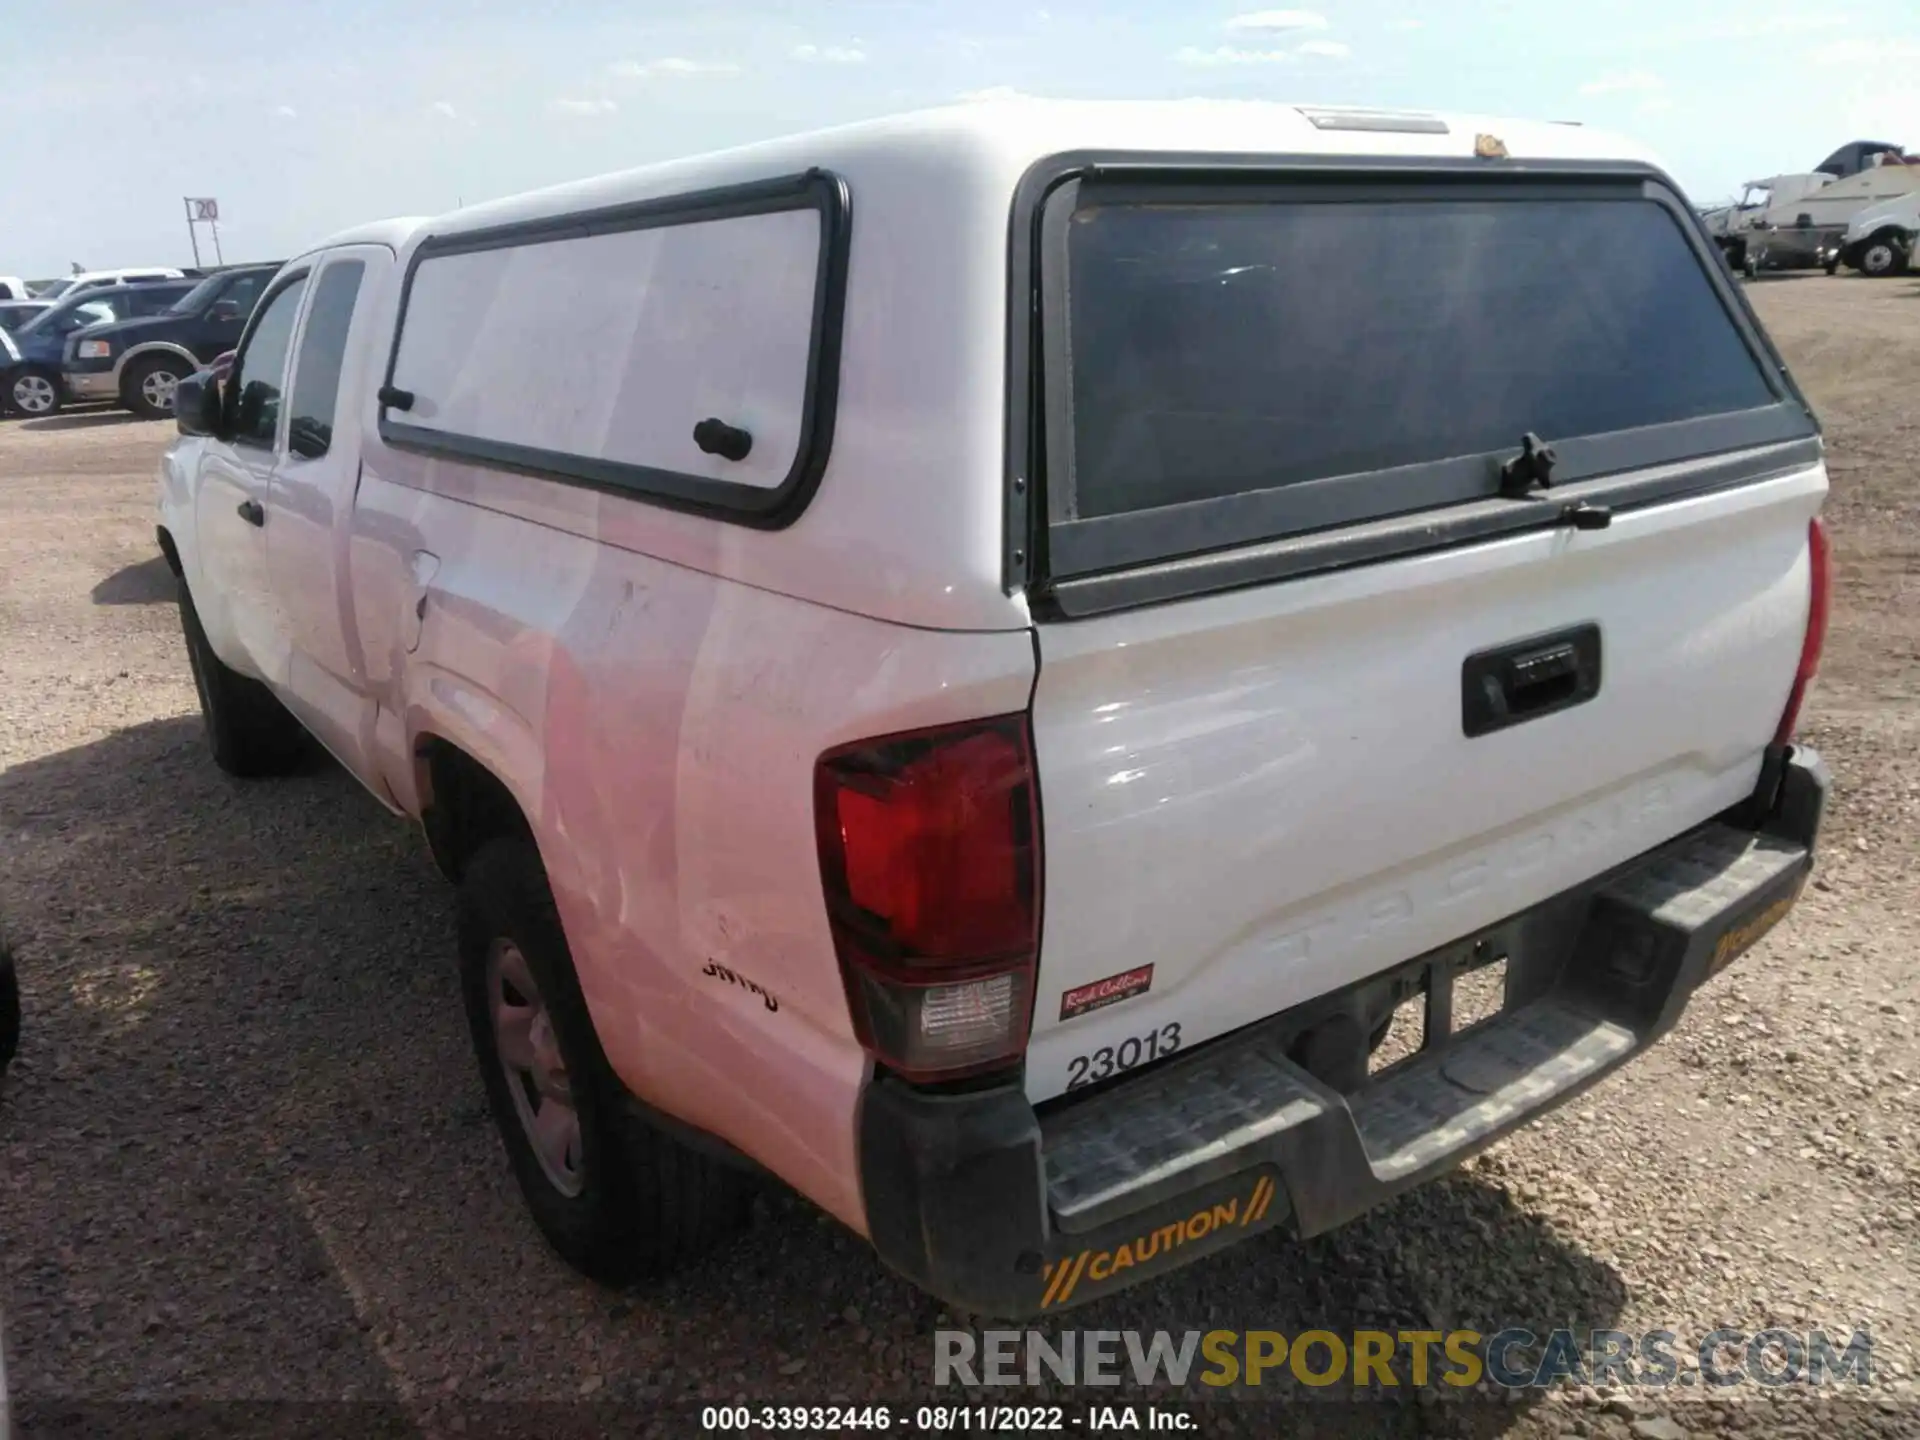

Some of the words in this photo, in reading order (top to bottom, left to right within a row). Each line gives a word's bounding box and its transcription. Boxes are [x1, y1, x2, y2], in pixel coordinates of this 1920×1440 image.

[196, 199, 218, 219] 20
[1066, 1021, 1182, 1090] 23013
[1088, 1197, 1238, 1282] CAUTION
